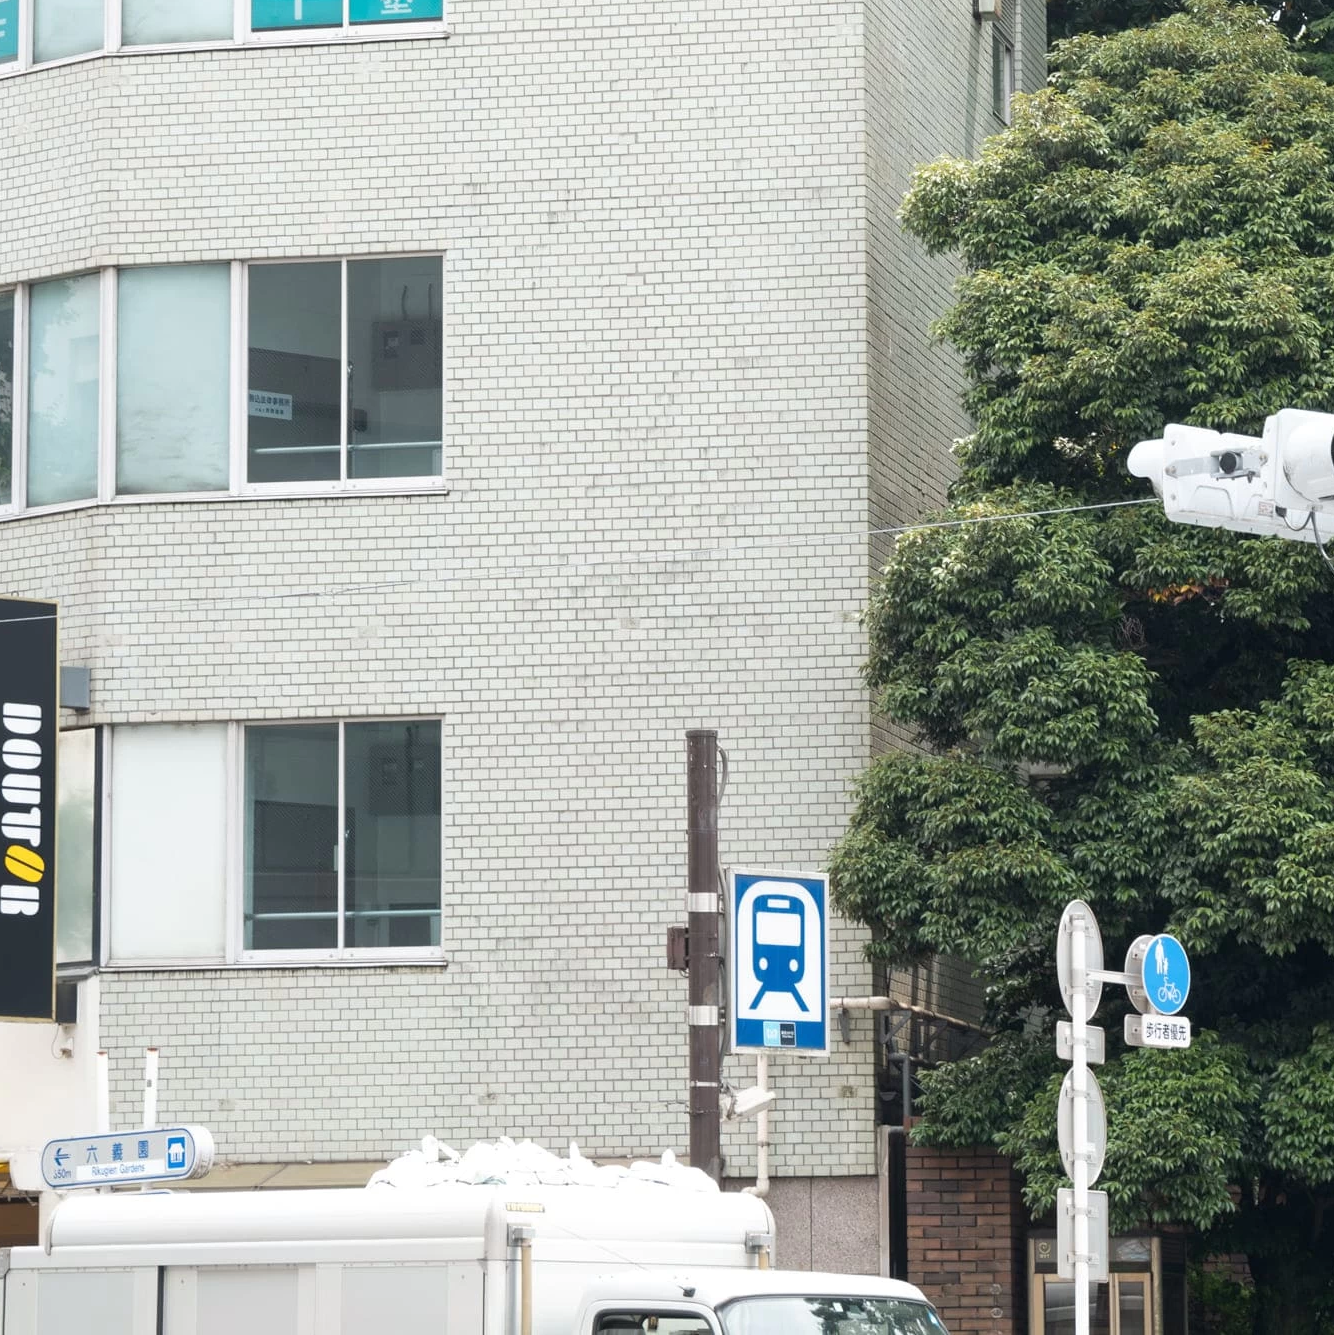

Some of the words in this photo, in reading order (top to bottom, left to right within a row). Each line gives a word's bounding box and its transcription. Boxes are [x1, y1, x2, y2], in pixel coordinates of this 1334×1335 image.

[0, 702, 45, 917] DOUTOR
[1146, 1022, 1187, 1041] 歩行者優先
[86, 1140, 149, 1164] 六義園
[119, 1163, 145, 1174] Gardens
